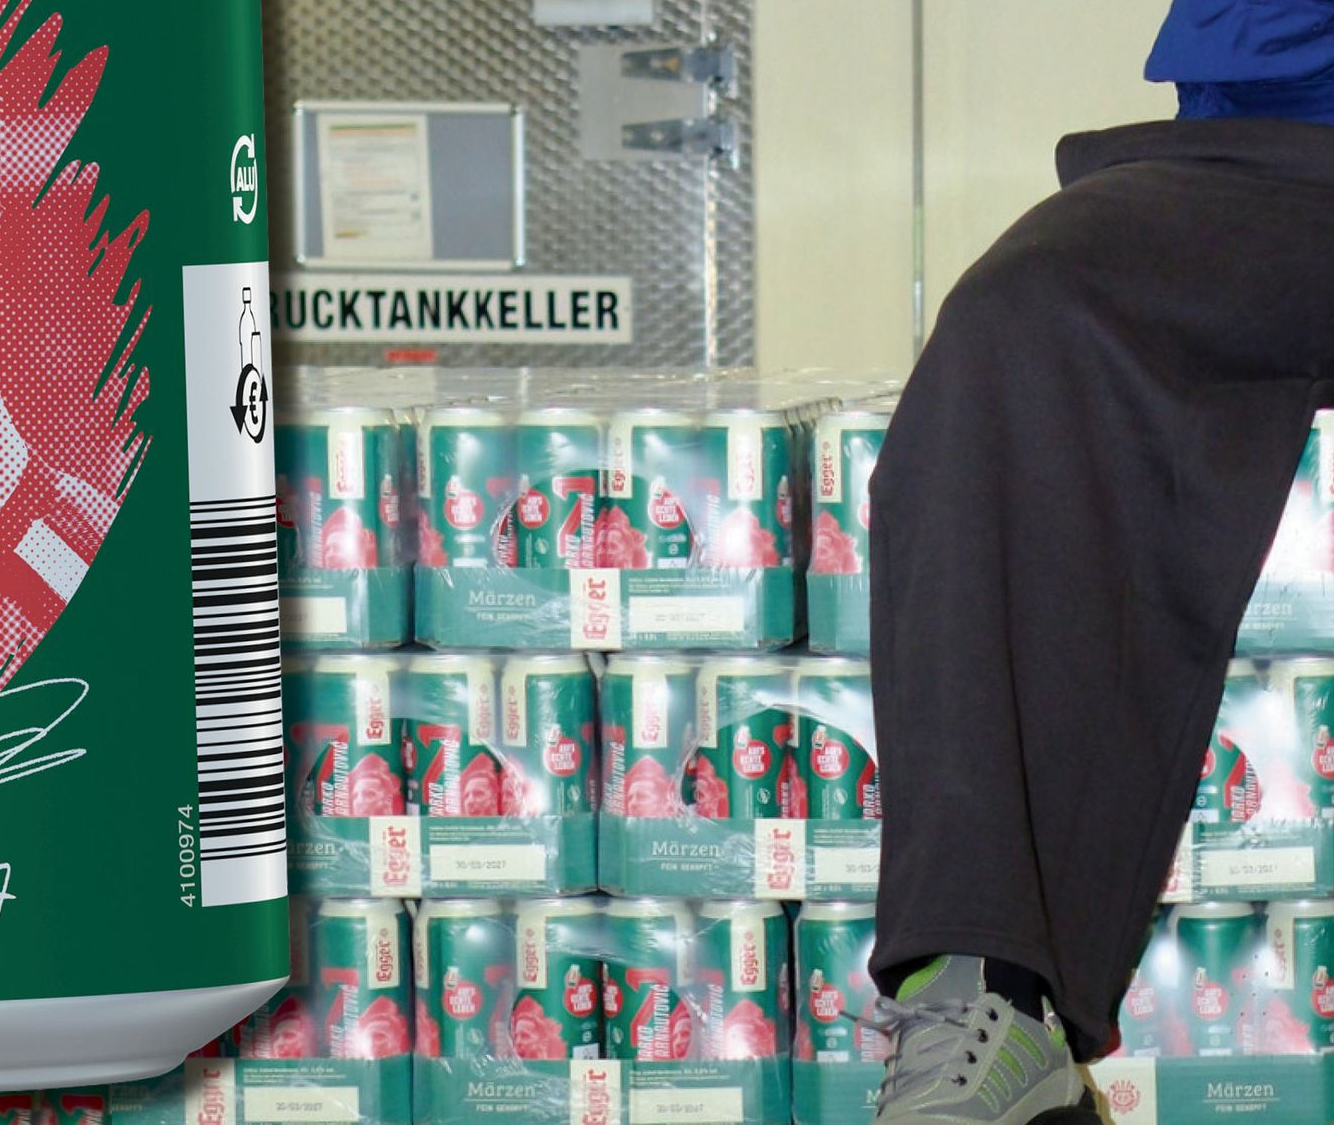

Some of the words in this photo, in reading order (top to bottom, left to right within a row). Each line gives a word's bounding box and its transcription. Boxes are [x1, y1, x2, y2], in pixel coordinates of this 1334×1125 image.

[236, 166, 255, 192] ALU
[468, 589, 537, 606] Märzen
[179, 803, 195, 908] 4100974
[651, 840, 721, 856] Märzen
[467, 1081, 536, 1097] Märzen
[1207, 1081, 1274, 1098] Märzen
